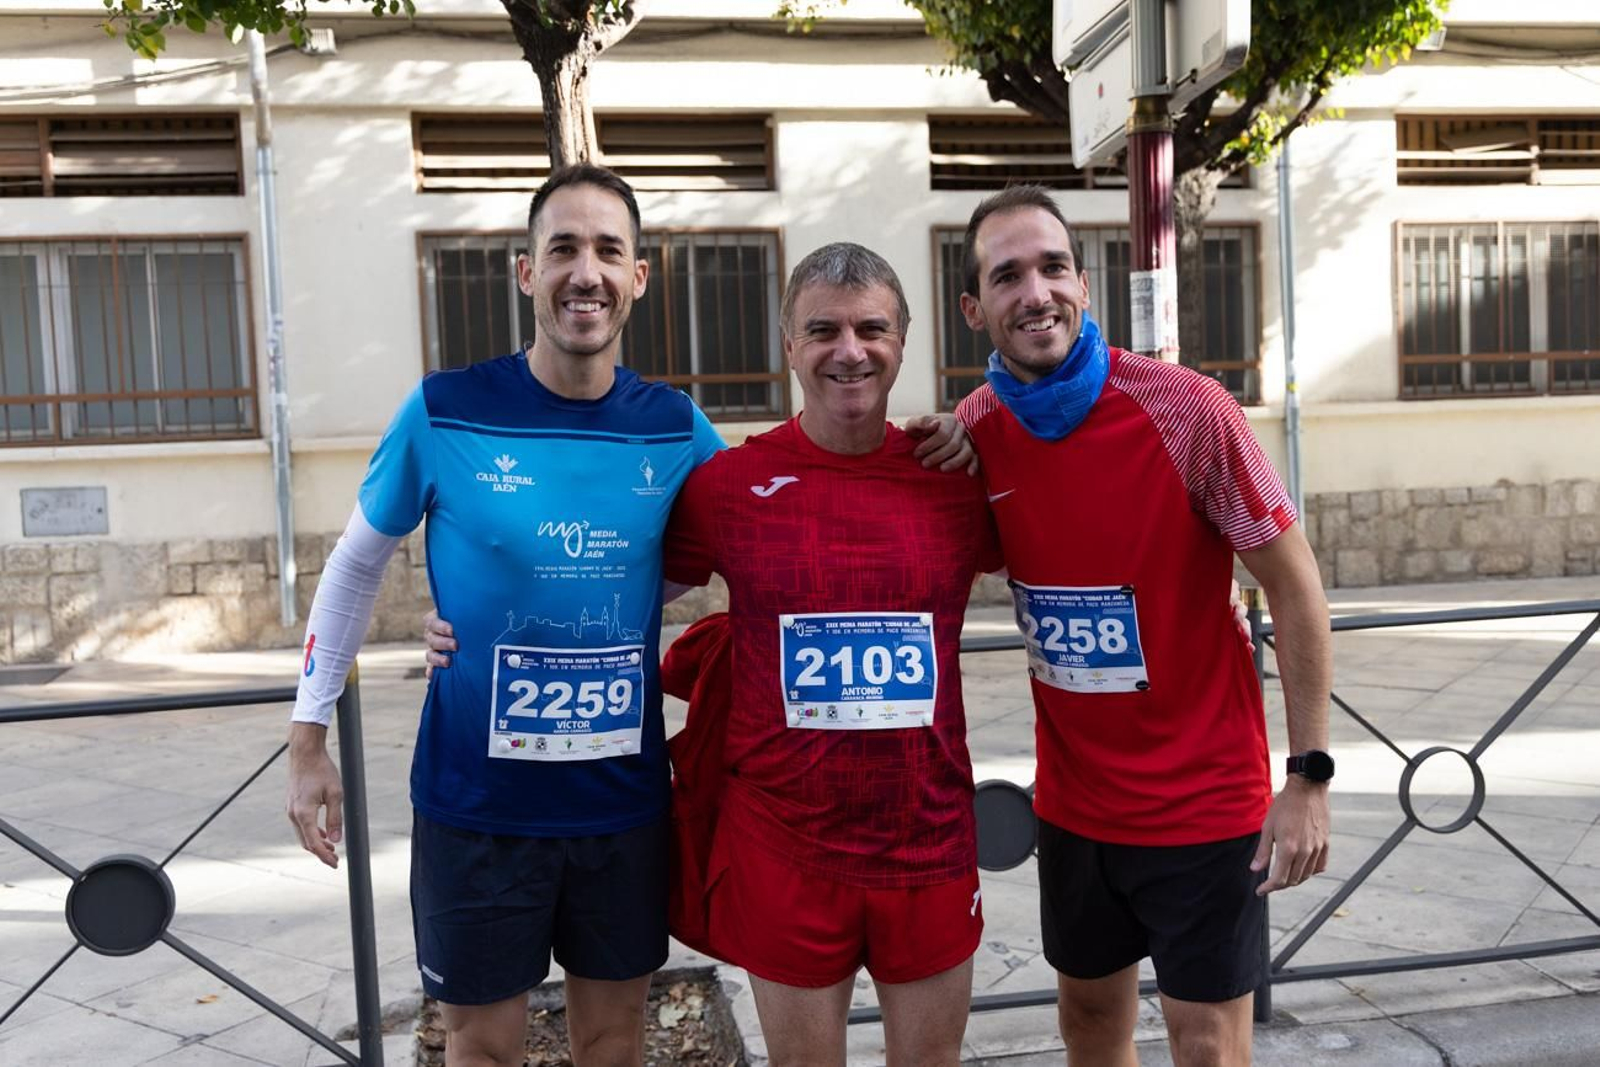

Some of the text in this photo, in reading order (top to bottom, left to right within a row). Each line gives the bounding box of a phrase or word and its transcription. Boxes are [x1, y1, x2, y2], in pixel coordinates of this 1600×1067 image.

[476, 472, 536, 486] CAJA RURAL
[492, 484, 518, 493] JAÉN
[589, 530, 618, 539] MEDIA
[586, 539, 630, 549] MARATÓN
[583, 549, 605, 559] JAÉN
[857, 620, 882, 628] MARATÓN
[1022, 612, 1128, 655] 2258
[1058, 653, 1085, 664] JAVIER
[795, 645, 925, 686] 2103
[841, 686, 883, 696] ANTONIO
[506, 679, 633, 719] 2259
[556, 718, 591, 730] VÍCTOR
